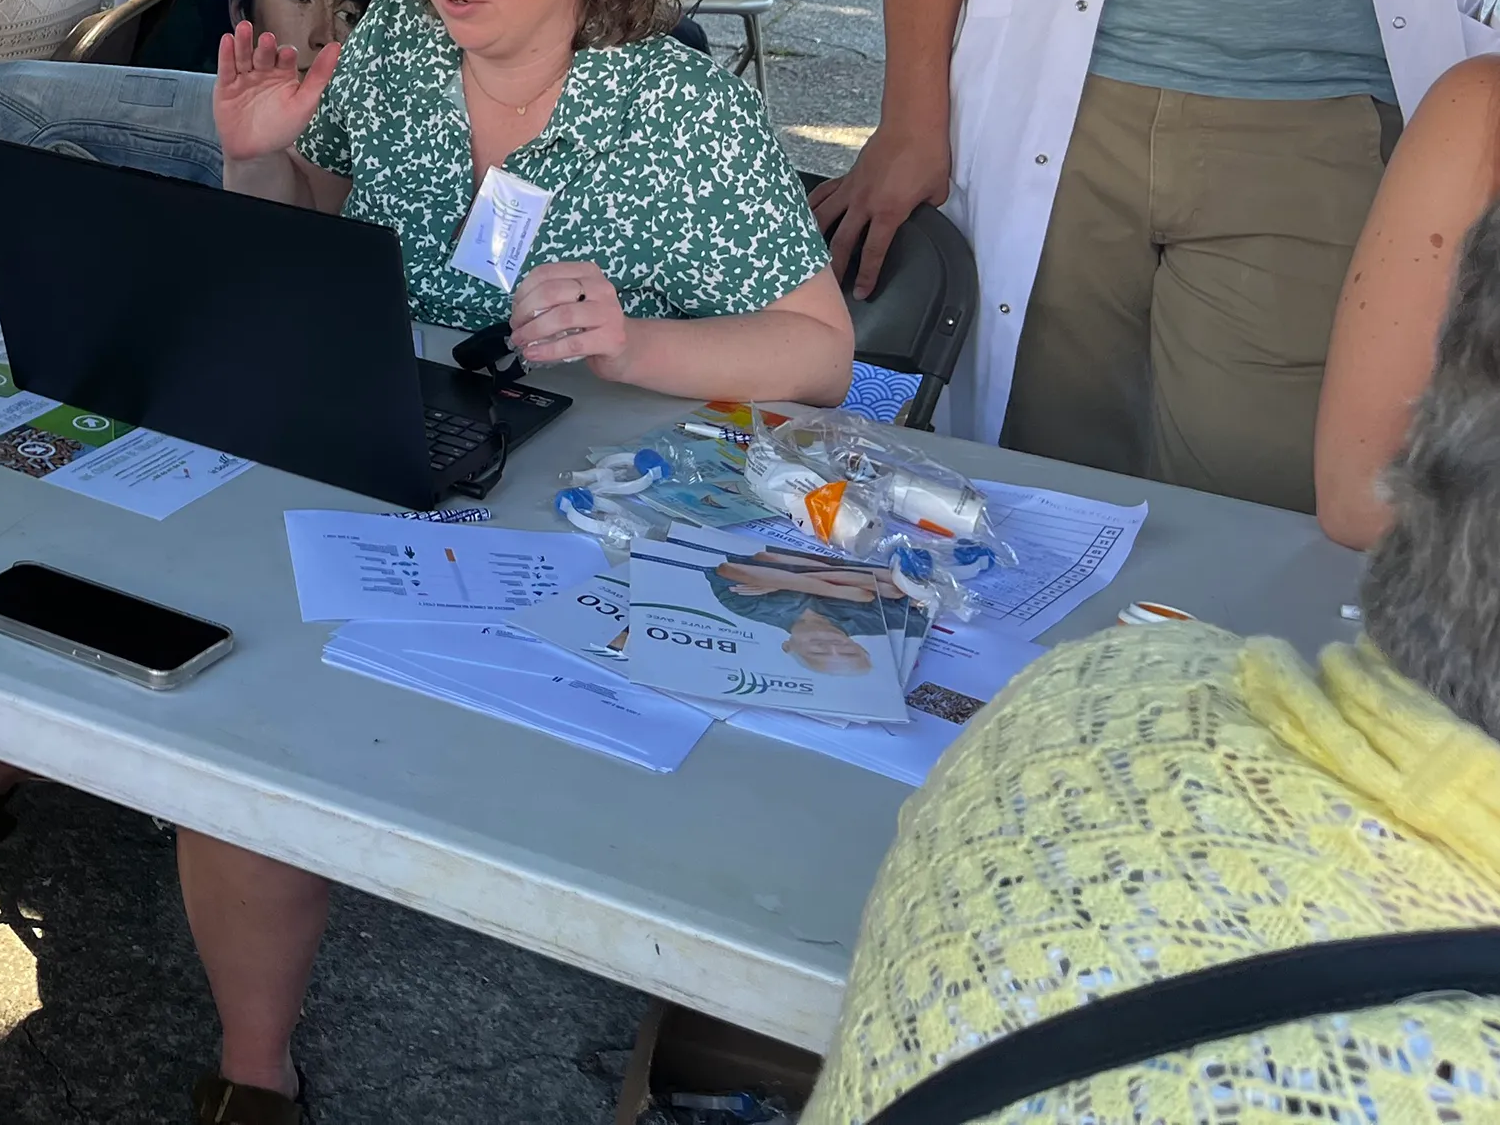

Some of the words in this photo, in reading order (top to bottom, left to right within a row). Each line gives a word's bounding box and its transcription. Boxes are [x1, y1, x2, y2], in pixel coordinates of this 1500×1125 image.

[505, 259, 517, 272] 17
[645, 612, 676, 624] avec
[646, 626, 738, 655] BPCO
[722, 667, 815, 696] Souffle
